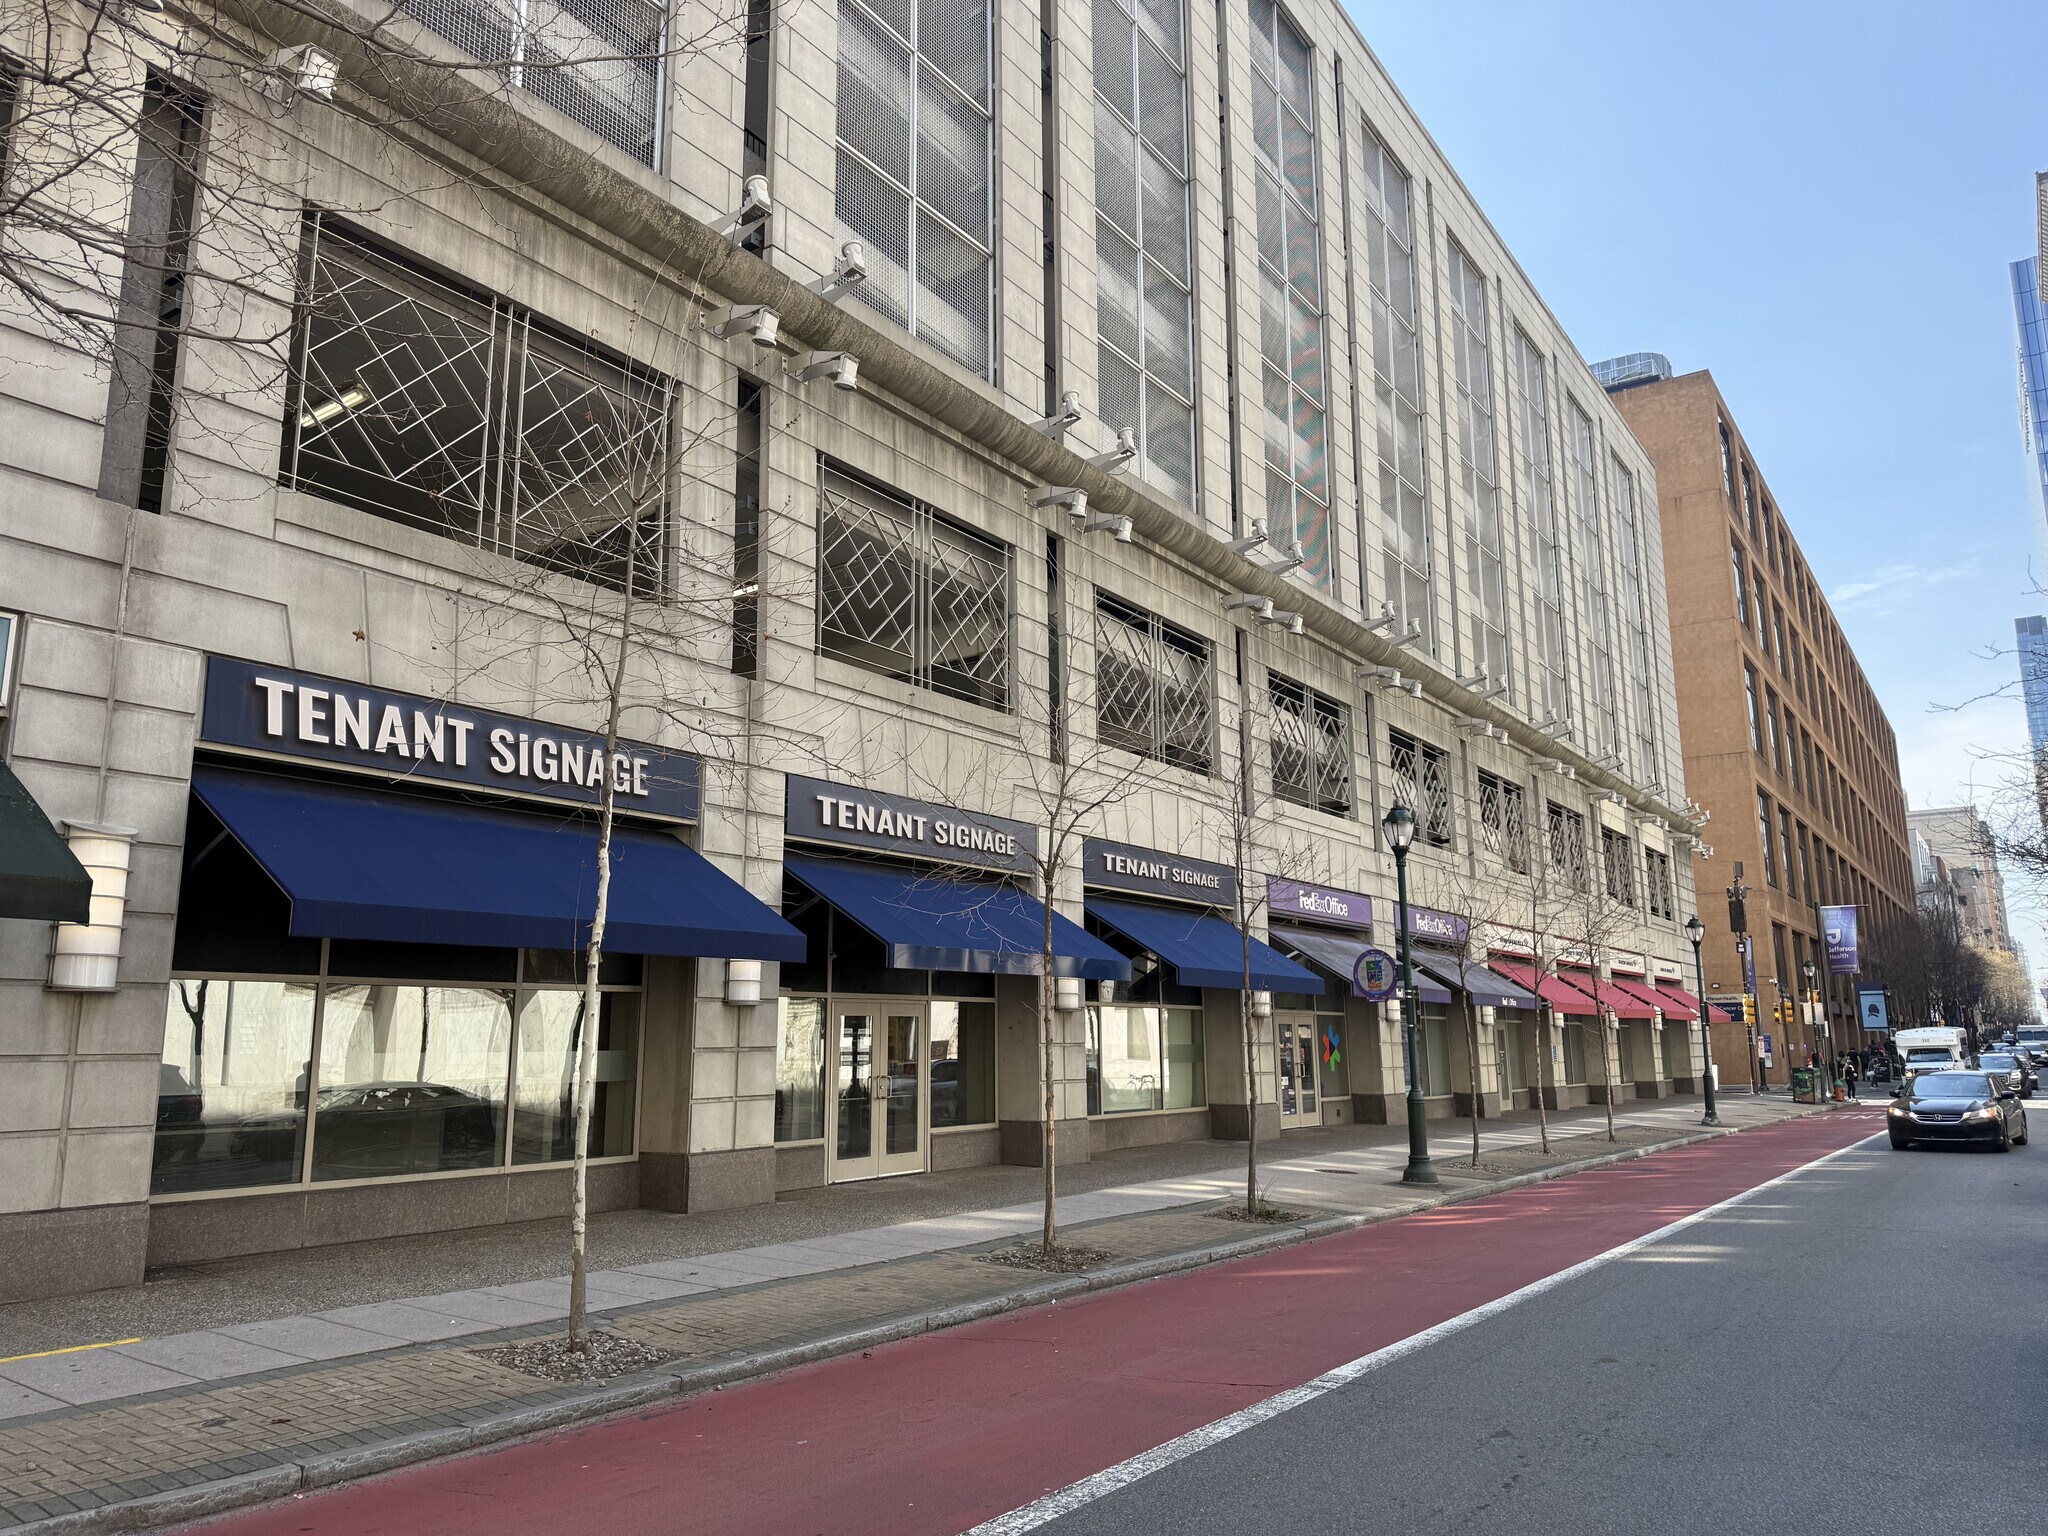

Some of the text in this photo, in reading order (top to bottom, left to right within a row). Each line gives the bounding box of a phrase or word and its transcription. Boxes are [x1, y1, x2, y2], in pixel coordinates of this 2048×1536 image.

[255, 676, 649, 797] TENANT SIGNAGE
[817, 795, 1016, 856] TENANT SIGNAGE
[1103, 852, 1220, 889] TENANT SIGNAGE
